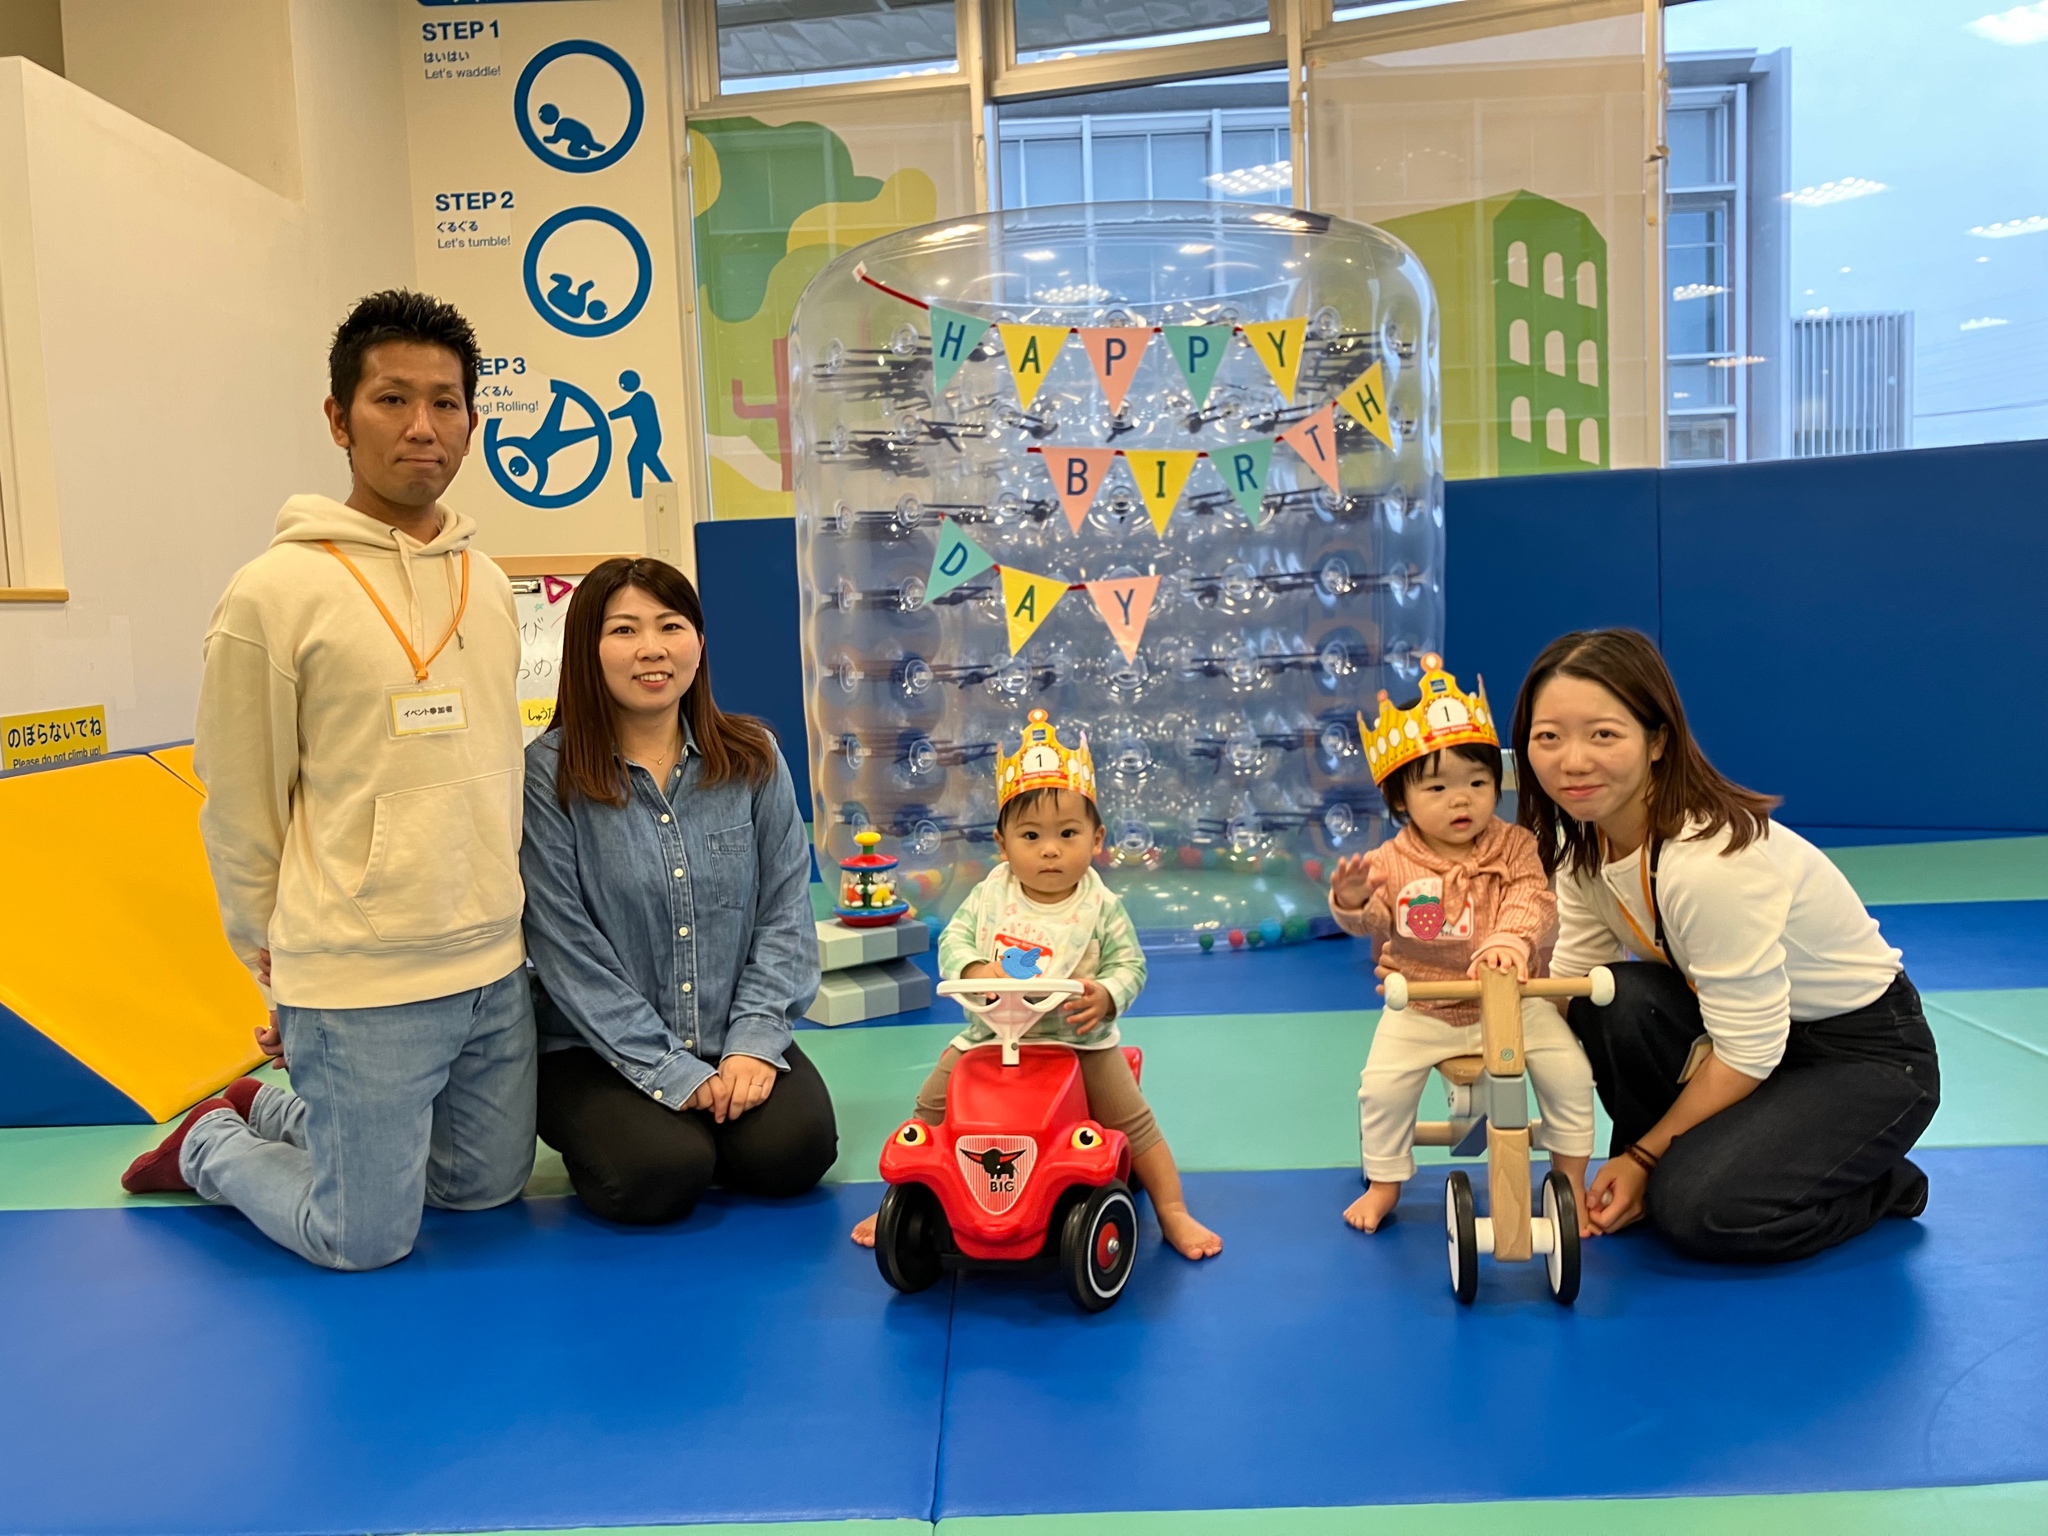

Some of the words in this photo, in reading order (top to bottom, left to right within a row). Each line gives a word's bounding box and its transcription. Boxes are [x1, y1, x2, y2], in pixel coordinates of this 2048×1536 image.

[422, 20, 484, 41] STEP
[489, 19, 499, 38] 1
[423, 51, 470, 63] はいはい
[425, 68, 453, 79] Let's
[456, 65, 501, 78] waddle!
[435, 192, 497, 211] STEP
[500, 191, 515, 209] 2
[437, 238, 465, 249] Let's
[468, 235, 511, 247] tumble!
[940, 321, 1287, 376] HAPPY
[479, 357, 509, 375] EP
[512, 356, 527, 375] 3
[496, 400, 539, 414] Rolling!
[1067, 383, 1382, 498] BIRTH
[939, 541, 1135, 625] DAY
[7, 716, 102, 748] のぼらないでね
[13, 758, 40, 769] Please
[41, 754, 52, 764] do
[54, 752, 66, 762] not
[68, 748, 88, 760] climb
[1035, 753, 1042, 768] 1
[990, 1181, 1014, 1192] BIG
